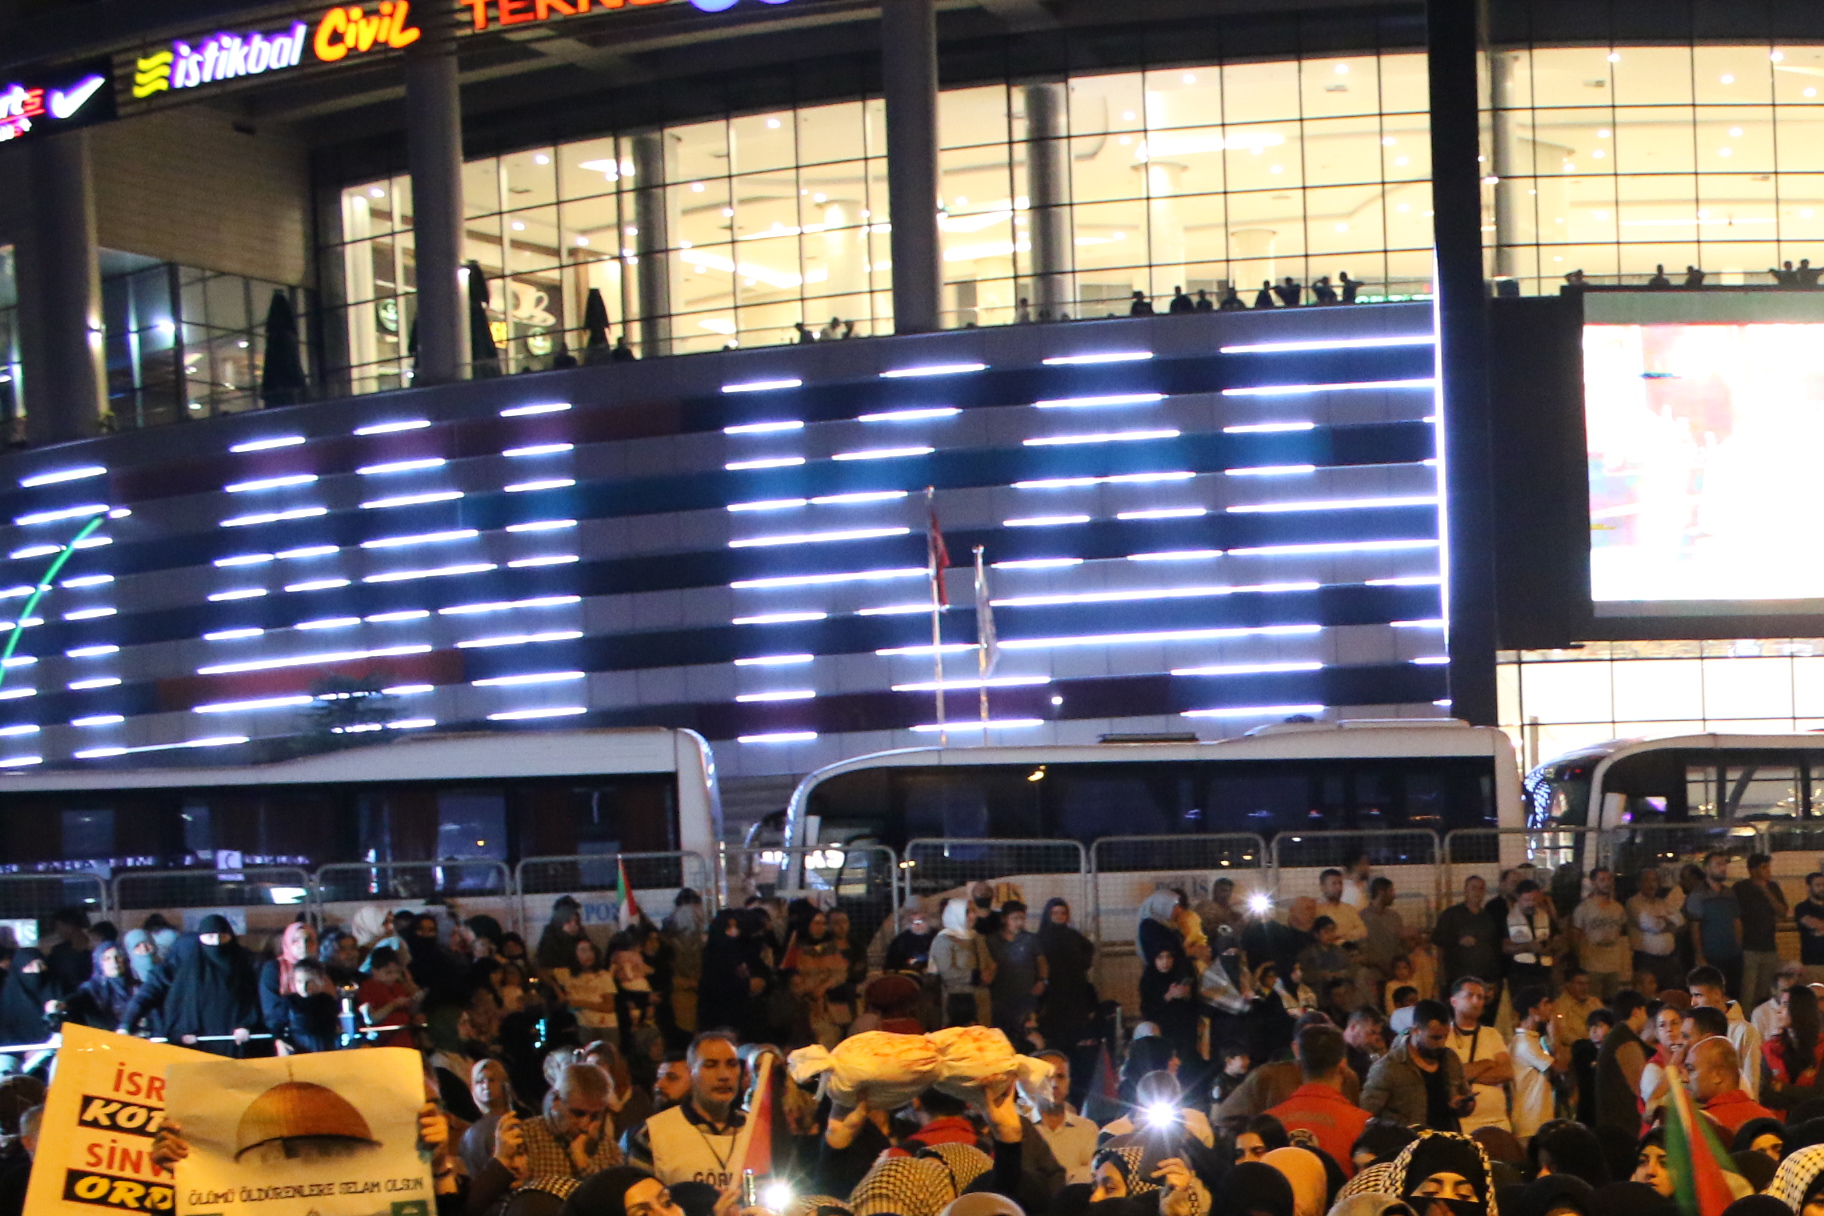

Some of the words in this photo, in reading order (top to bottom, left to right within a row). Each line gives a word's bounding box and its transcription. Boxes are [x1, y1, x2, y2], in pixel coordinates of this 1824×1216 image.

[172, 22, 307, 88] istikbal
[113, 1061, 166, 1102] İSR
[74, 1175, 174, 1211] ORD
[339, 1180, 381, 1195] SELAM
